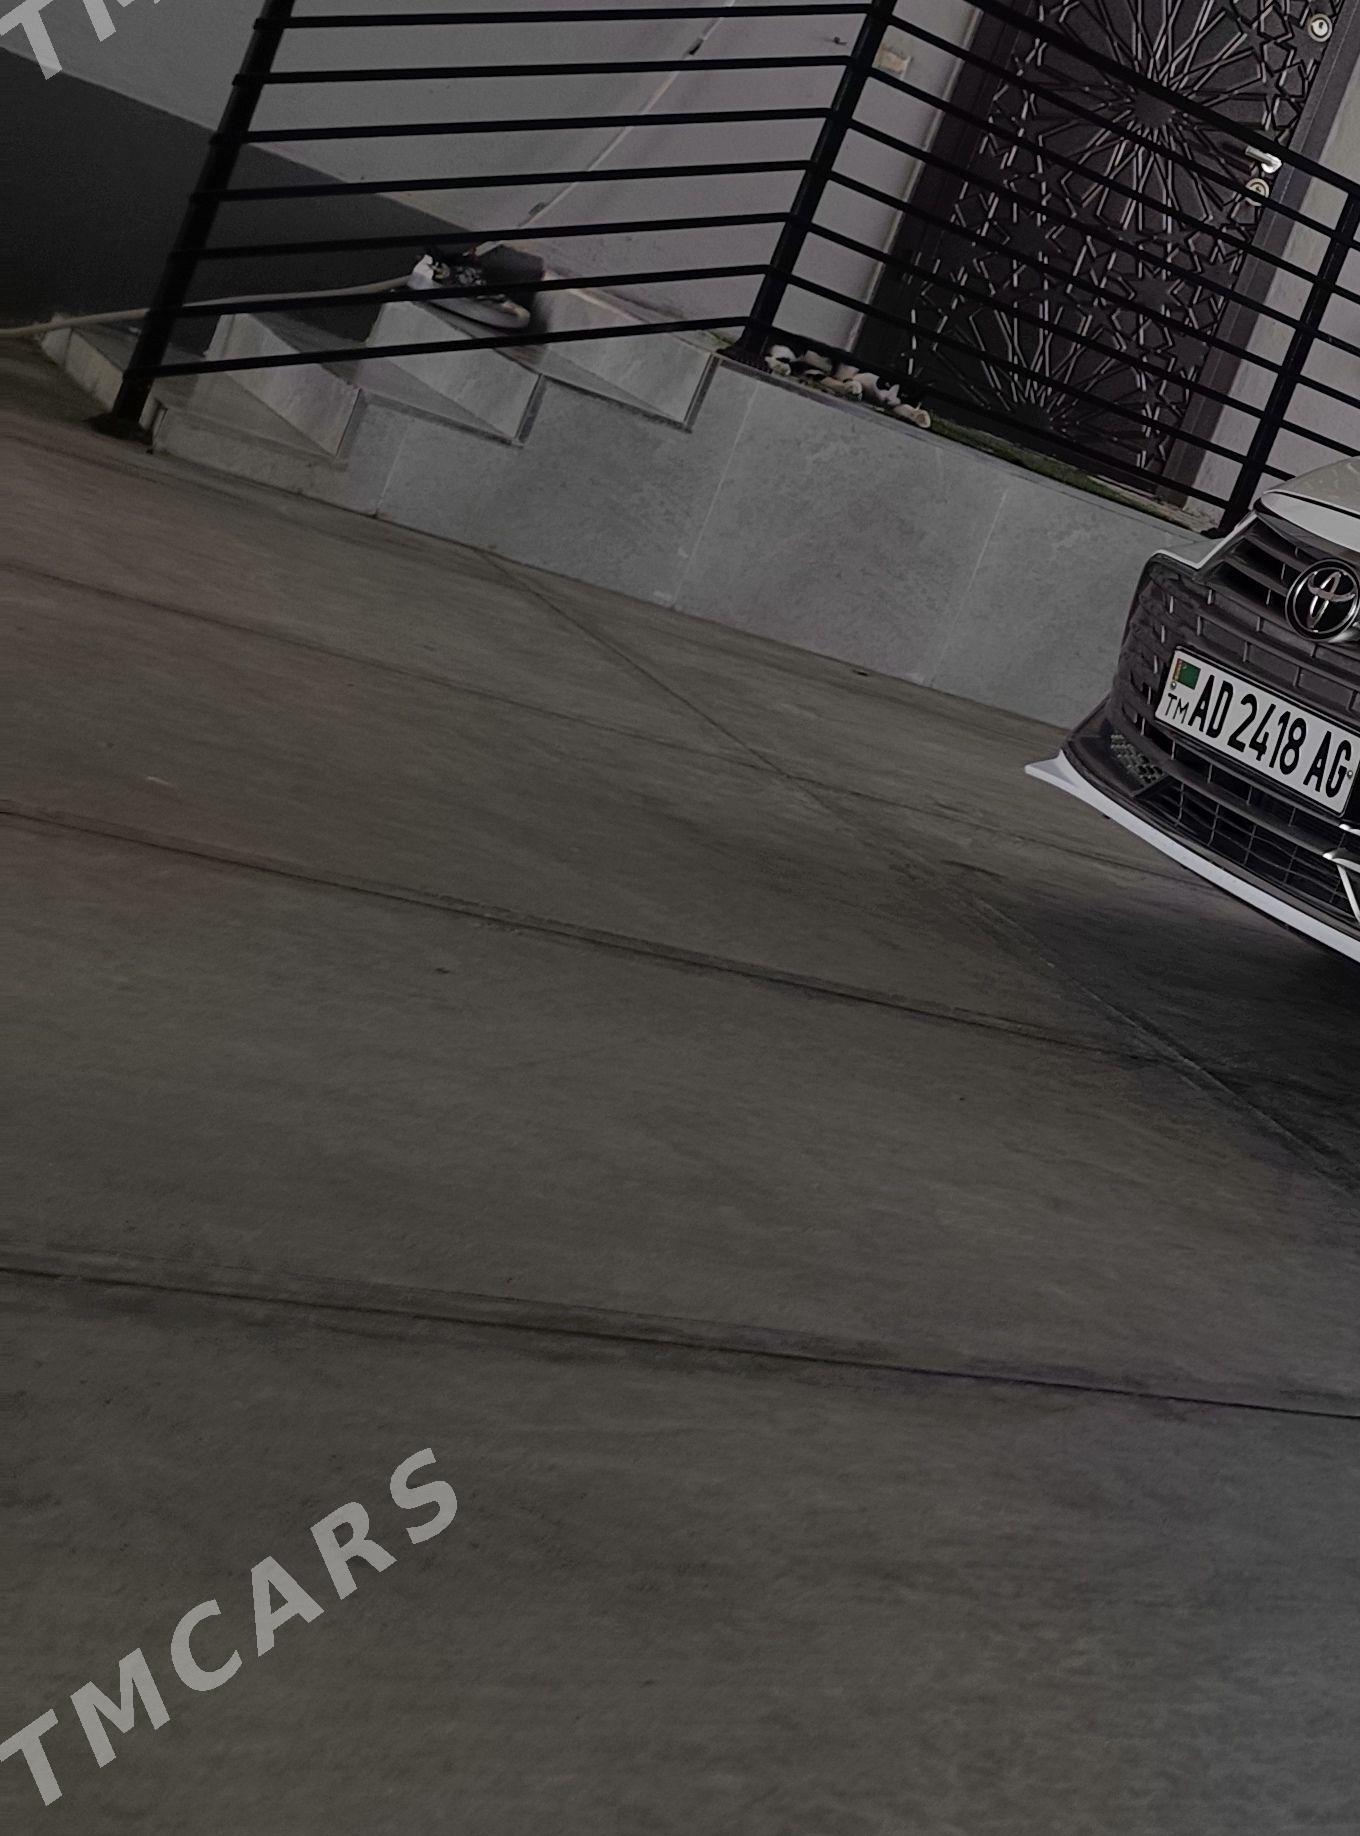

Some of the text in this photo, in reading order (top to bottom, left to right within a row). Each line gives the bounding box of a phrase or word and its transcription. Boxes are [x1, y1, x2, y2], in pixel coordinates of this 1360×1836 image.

[1165, 692, 1190, 724] TM
[1189, 675, 1351, 798] AD 2418 AG
